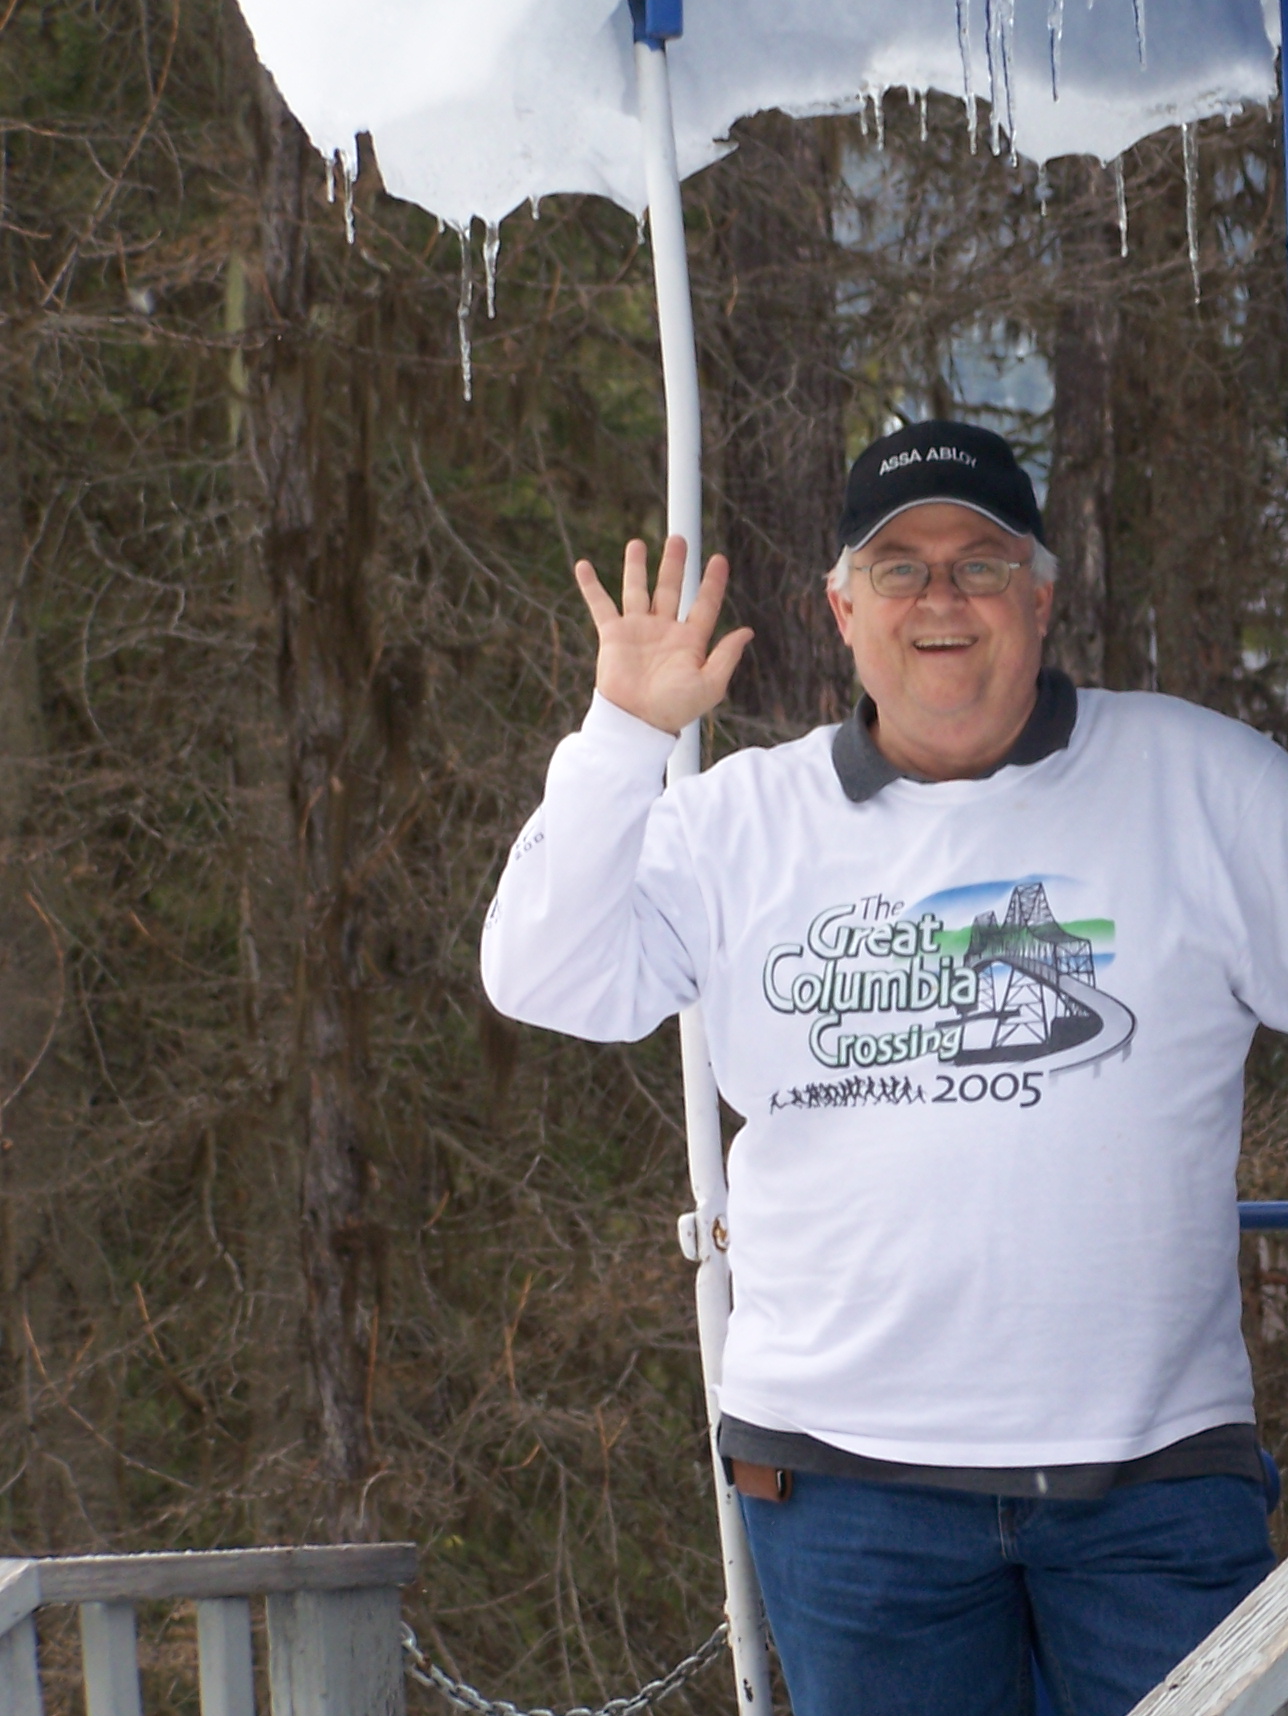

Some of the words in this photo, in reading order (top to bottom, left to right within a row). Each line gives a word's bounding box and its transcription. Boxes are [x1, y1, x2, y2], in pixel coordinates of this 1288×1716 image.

[880, 448, 922, 476] ASSA
[860, 893, 905, 921] The
[808, 904, 944, 960] Great
[763, 942, 979, 1015] Columbia
[809, 1013, 964, 1068] Crossing
[931, 1072, 1044, 1108] 2005
